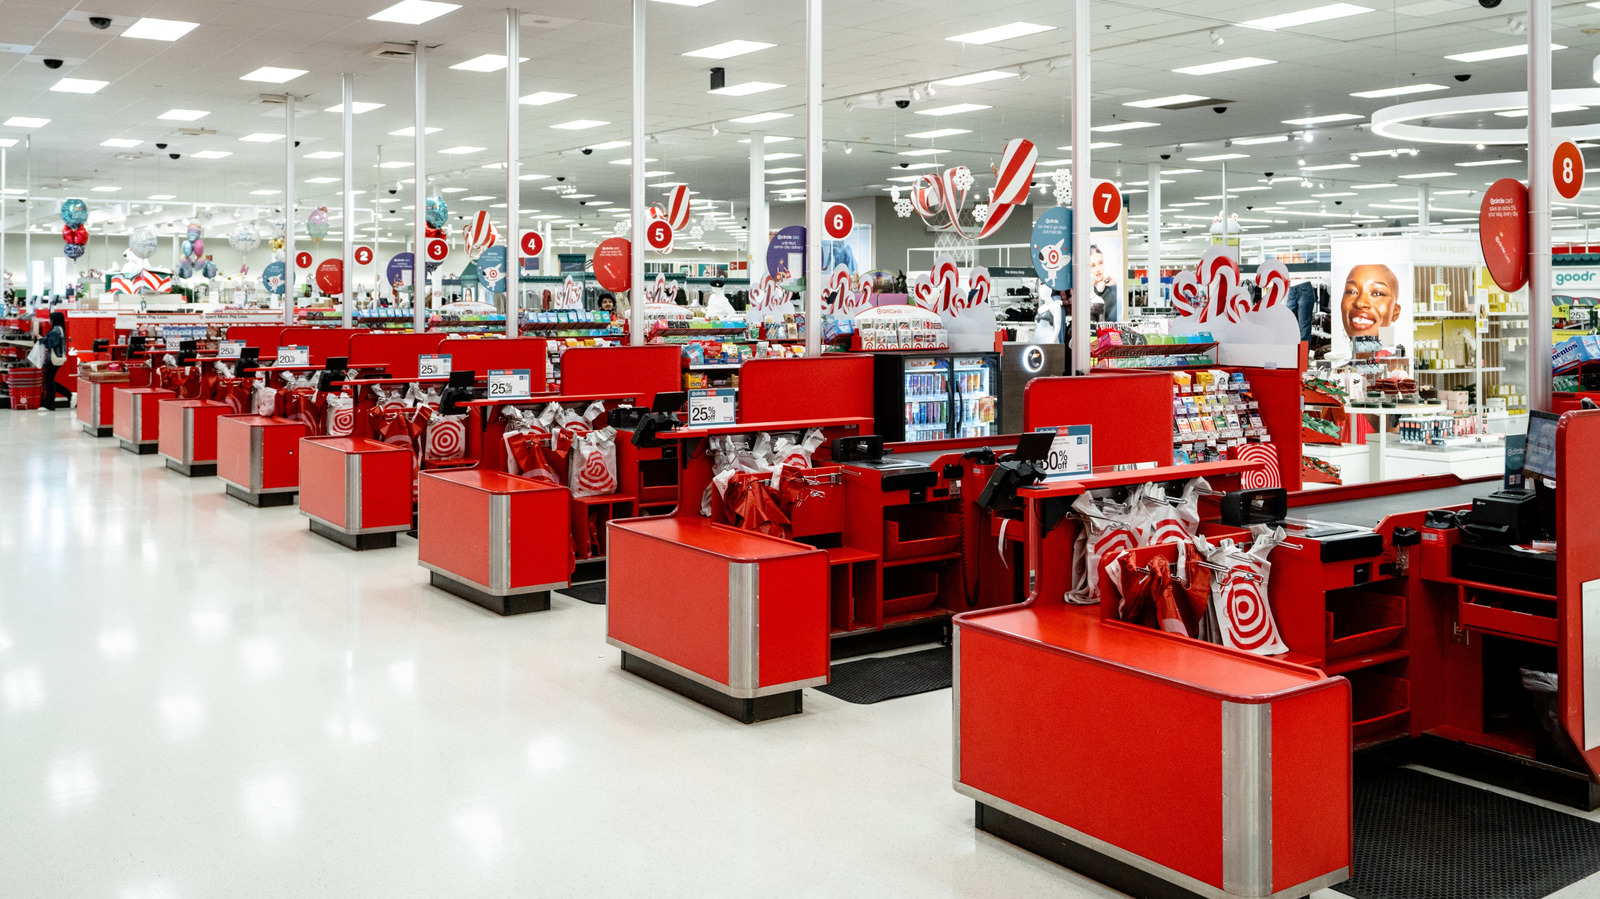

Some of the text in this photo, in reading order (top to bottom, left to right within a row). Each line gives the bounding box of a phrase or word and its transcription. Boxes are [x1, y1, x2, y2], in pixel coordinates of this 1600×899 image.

[1562, 158, 1574, 184] 8
[1102, 194, 1112, 213] 7
[833, 214, 844, 230] 6
[655, 228, 665, 242] 5
[434, 245, 442, 255] 3
[528, 239, 536, 250] 4
[1449, 245, 1470, 254] SCOTT
[301, 256, 306, 264] 1
[360, 251, 368, 261] 2
[1556, 271, 1596, 285] goodr
[422, 365, 432, 374] 25
[491, 383, 506, 394] 25
[692, 407, 708, 421] 25
[708, 406, 716, 415] %
[1059, 450, 1068, 461] %
[1058, 461, 1068, 469] off
